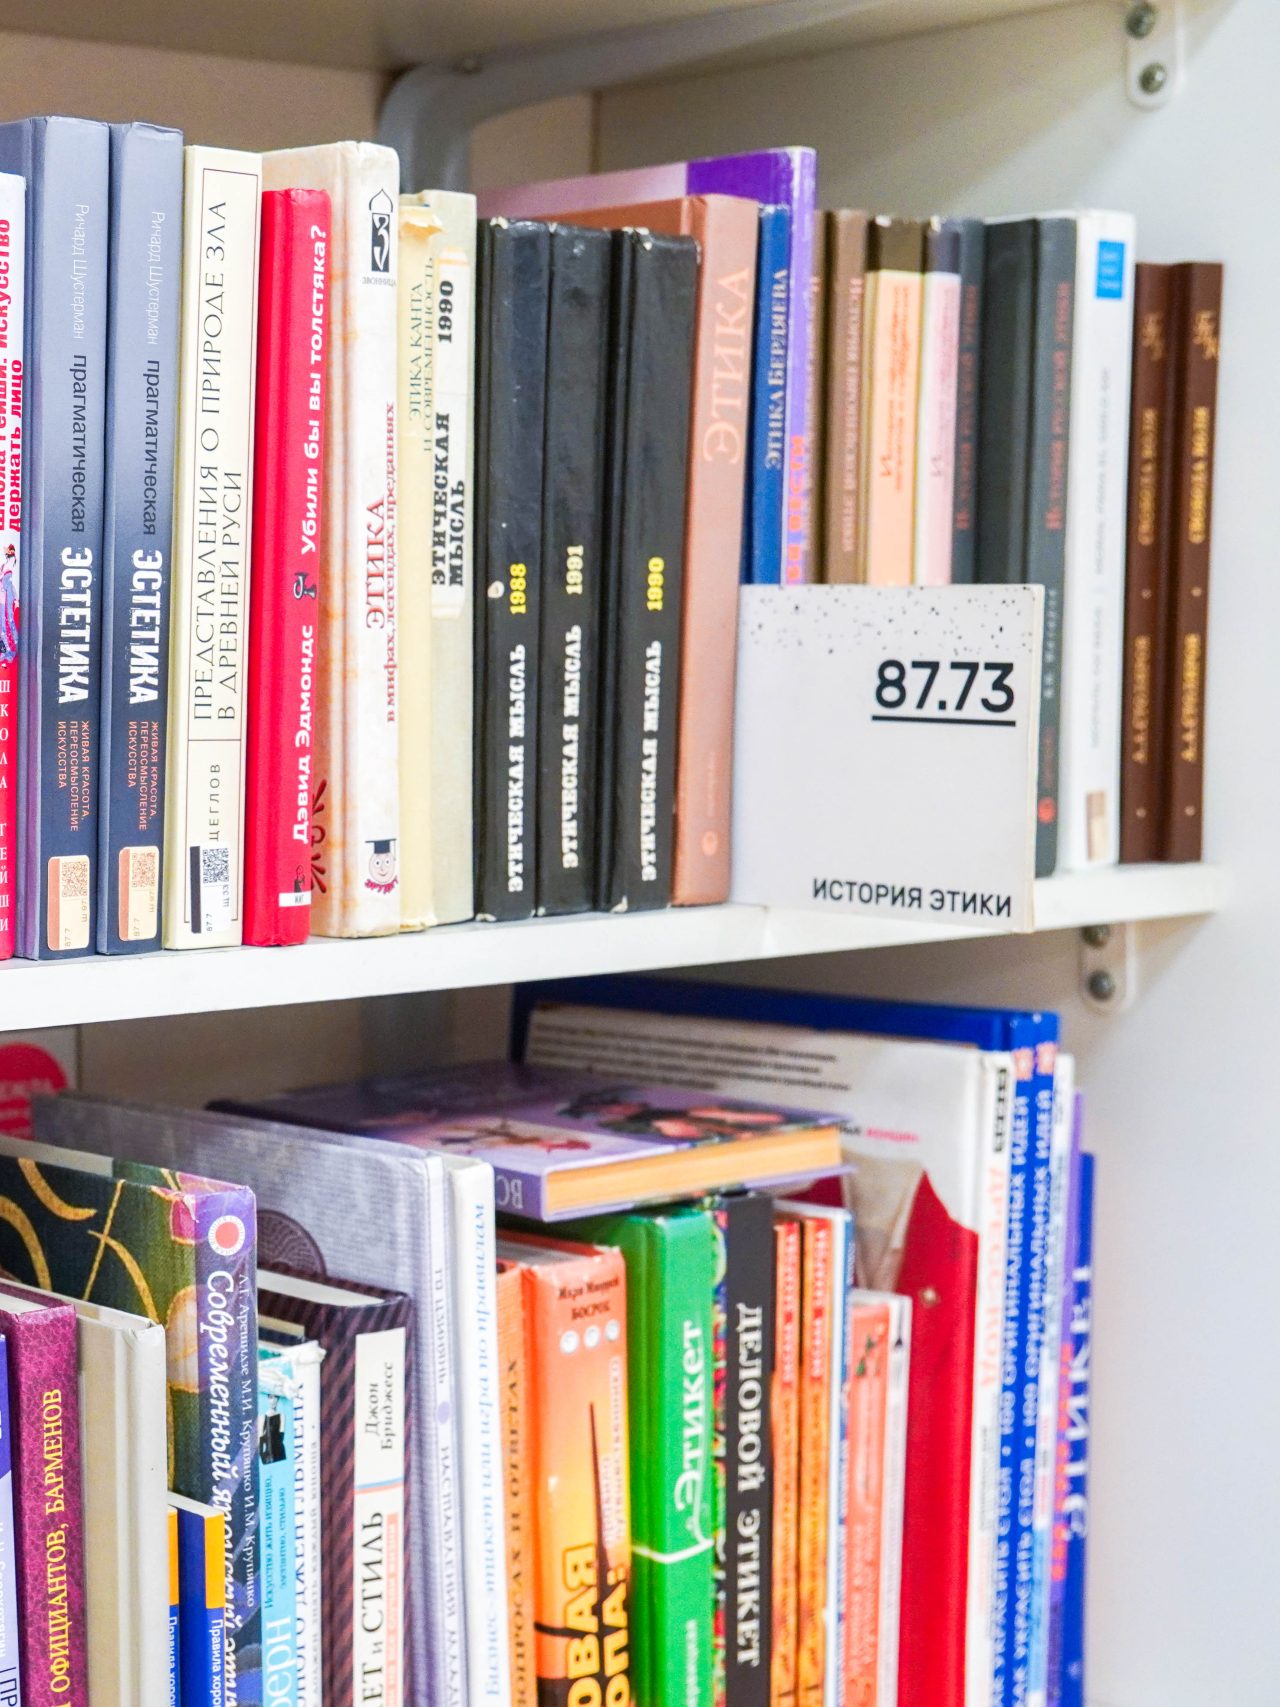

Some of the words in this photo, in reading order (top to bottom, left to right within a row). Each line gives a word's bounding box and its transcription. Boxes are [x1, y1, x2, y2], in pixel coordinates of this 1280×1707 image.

[71, 205, 89, 255] Ричард
[147, 212, 166, 262] Ричард
[206, 201, 227, 261] ЗЛА
[72, 256, 89, 339] Шустерман
[147, 263, 164, 345] Шустерман
[310, 225, 328, 362] толстяка?
[410, 283, 422, 348] КАНТА
[438, 280, 454, 343] 1990
[202, 272, 224, 414] ПРИРОДЕ
[703, 268, 750, 465] ЭТИКА
[10, 359, 23, 419] лицо
[309, 374, 320, 411] вы
[409, 355, 422, 421] ЭТИКА
[765, 388, 785, 471] ЭТИКА
[8, 426, 21, 532] держать
[70, 354, 88, 533] прагматическая
[142, 360, 160, 535] прагматическая
[200, 428, 220, 452] О
[304, 425, 320, 459] бы
[222, 471, 242, 546] РУСИ
[301, 470, 318, 553] Убили
[431, 412, 449, 587] ЭТИЧЕСКАЯ
[449, 479, 465, 587] МЫСЛЬ
[194, 464, 219, 720] ПРЕДСТАВЛЕНИЯ
[366, 497, 384, 629] ЭТИКА
[510, 563, 527, 615] 1988
[566, 545, 584, 595] 1991
[647, 556, 664, 612] 1990
[58, 547, 93, 704] ЭСТЕТИКА
[129, 549, 163, 705] ЭСТЕТИКА
[219, 564, 239, 693] ДРЕВНЕЙ
[295, 625, 314, 748] Эдмондс
[510, 644, 525, 738] МЫСЛЬ
[564, 625, 581, 717] МЫСЛЬ
[644, 641, 661, 732] МЫСЛЬ
[875, 660, 1015, 714] 87.73
[58, 721, 66, 788] ИСКУССТВА
[82, 721, 90, 762] ЖИВАЯ
[128, 721, 137, 788] ИСКУССТВА
[218, 706, 235, 720] В
[70, 721, 79, 831] ПЕРЕОСМЫСЛЕНИЕ
[82, 767, 90, 820] КРАСОТА,
[139, 721, 148, 831] ПЕРЕОСМЫСЛЕНИЕ
[150, 767, 158, 820] КРАСОТА,
[209, 764, 220, 841] ЩЕГЛОВ
[293, 755, 310, 844] Дэвид
[562, 723, 579, 869] ЭТИЧЕСКАЯ
[641, 738, 658, 881] ЭТИЧЕСКАЯ
[508, 744, 524, 892] ЭТИЧЕСКАЯ
[813, 877, 922, 910] ИСТОРИЯ
[929, 889, 1013, 918] ЭТИКИ
[200, 1271, 238, 1486] Современный
[238, 1301, 250, 1375] Арешидзе
[240, 1379, 252, 1410] М.И.
[366, 1382, 380, 1435] Джон
[382, 1362, 396, 1450] Бриджесс
[675, 1319, 706, 1511] Этикет
[736, 1303, 765, 1492] ДЕЛОВОЙ
[42, 1389, 66, 1515] БАРМЕНОВ
[239, 1416, 253, 1492] Крупянко
[242, 1495, 256, 1530] И.М.
[46, 1523, 70, 1692] ОФИЦИАНТОВ,
[242, 1534, 256, 1608] Крупянко
[362, 1512, 383, 1633] СТИЛЬ
[736, 1509, 761, 1667] ЭТИКЕТ
[209, 1619, 224, 1675] Правила
[372, 1642, 382, 1654] и
